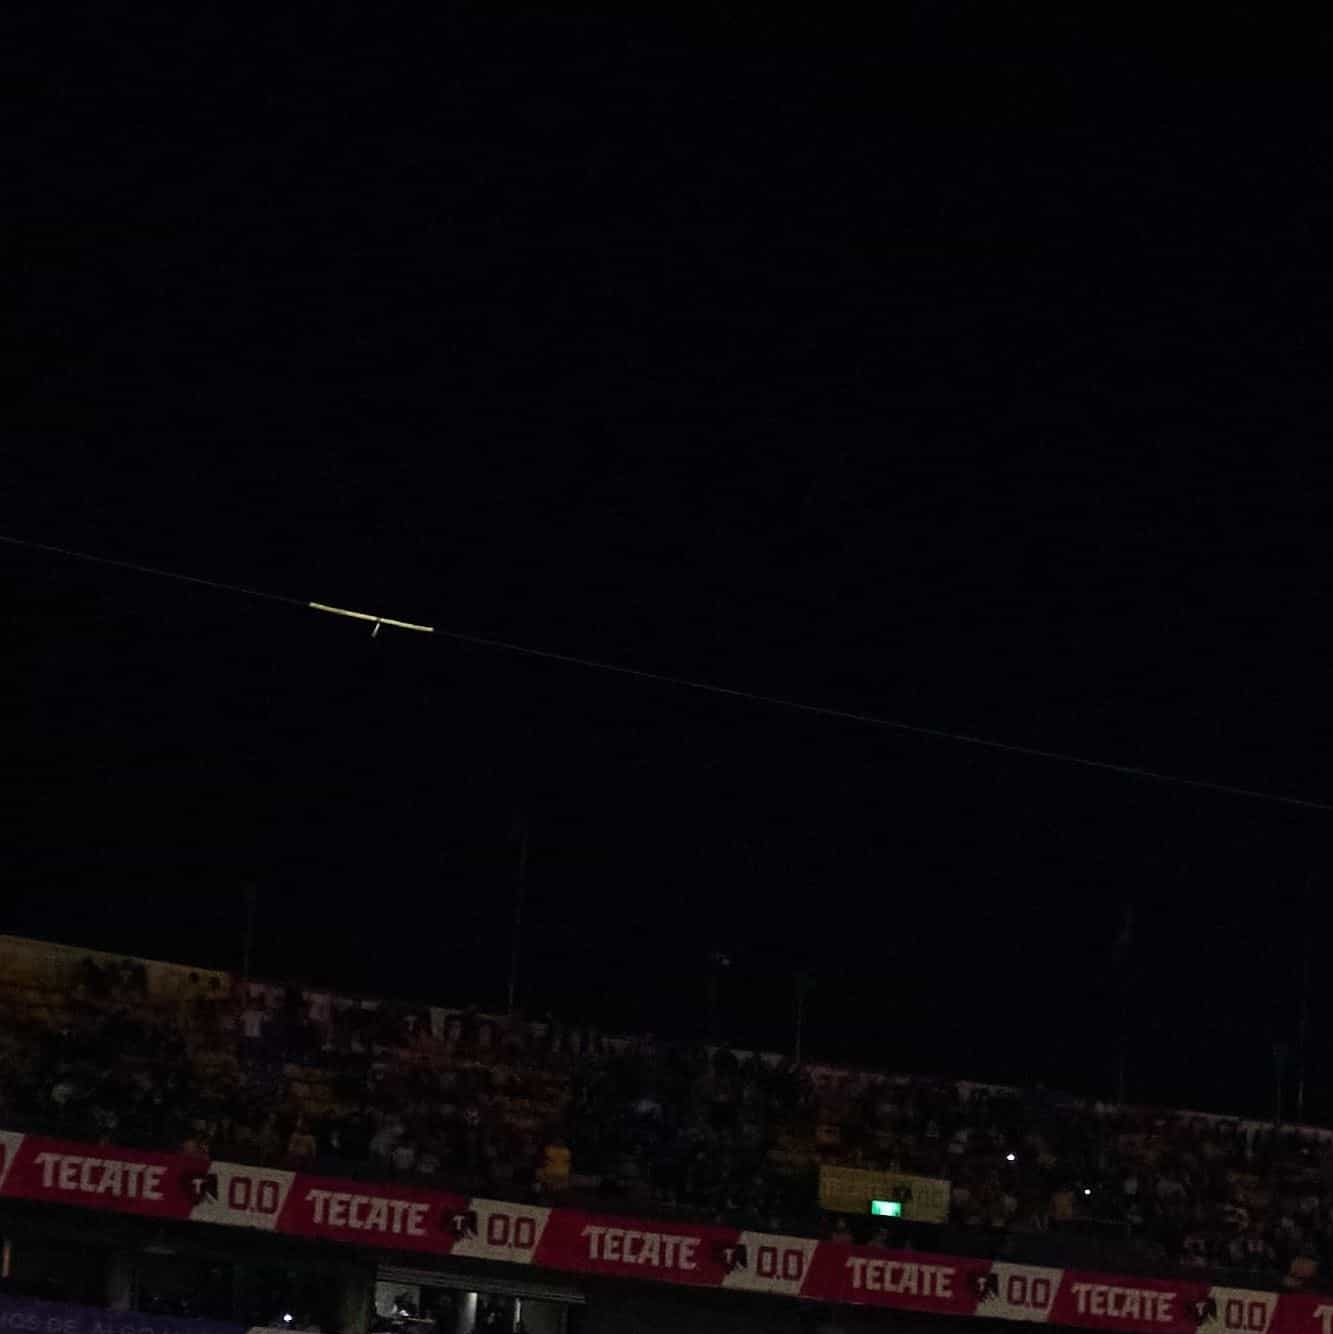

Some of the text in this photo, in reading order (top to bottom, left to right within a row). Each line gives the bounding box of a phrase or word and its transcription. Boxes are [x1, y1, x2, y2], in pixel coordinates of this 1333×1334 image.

[33, 1152, 169, 1199] TECATE
[306, 1188, 430, 1236] TECATE
[580, 1225, 701, 1270] TECATE
[844, 1256, 956, 1298] TECATE
[1071, 1283, 1176, 1322] TECATE
